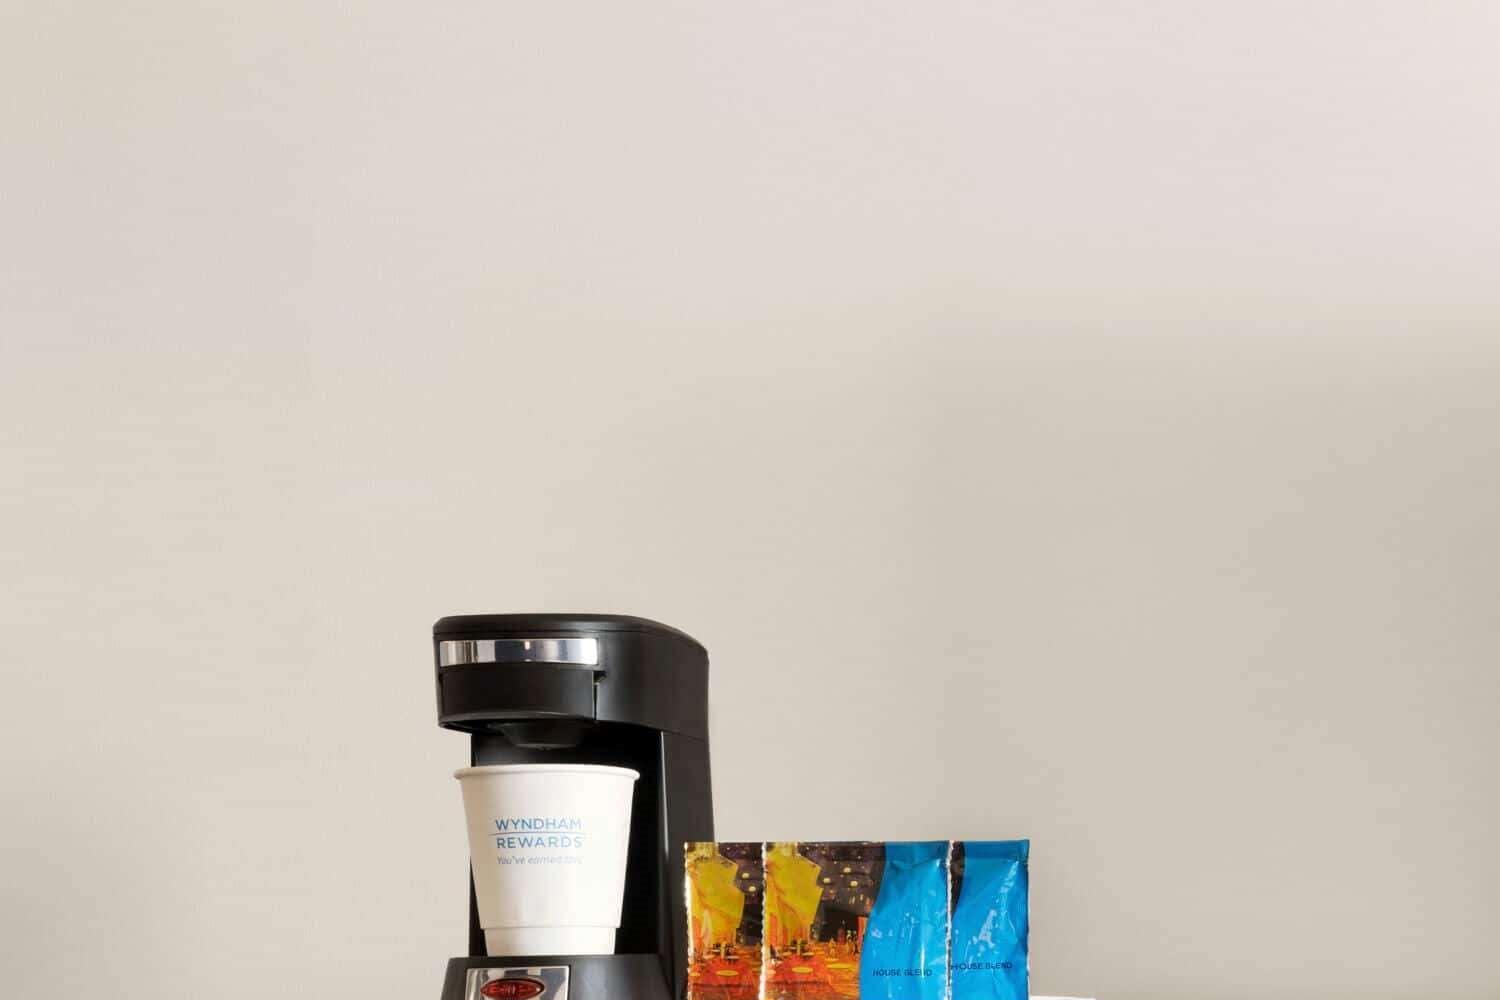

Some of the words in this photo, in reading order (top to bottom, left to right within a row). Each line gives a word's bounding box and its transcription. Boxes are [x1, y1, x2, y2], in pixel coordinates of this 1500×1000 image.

[495, 818, 582, 831] WYNDHAM
[497, 836, 584, 849] REWARDS
[497, 855, 526, 865] You've
[950, 962, 983, 972] HOUSE
[985, 961, 1013, 971] BLEND
[872, 968, 901, 977] HOUSE
